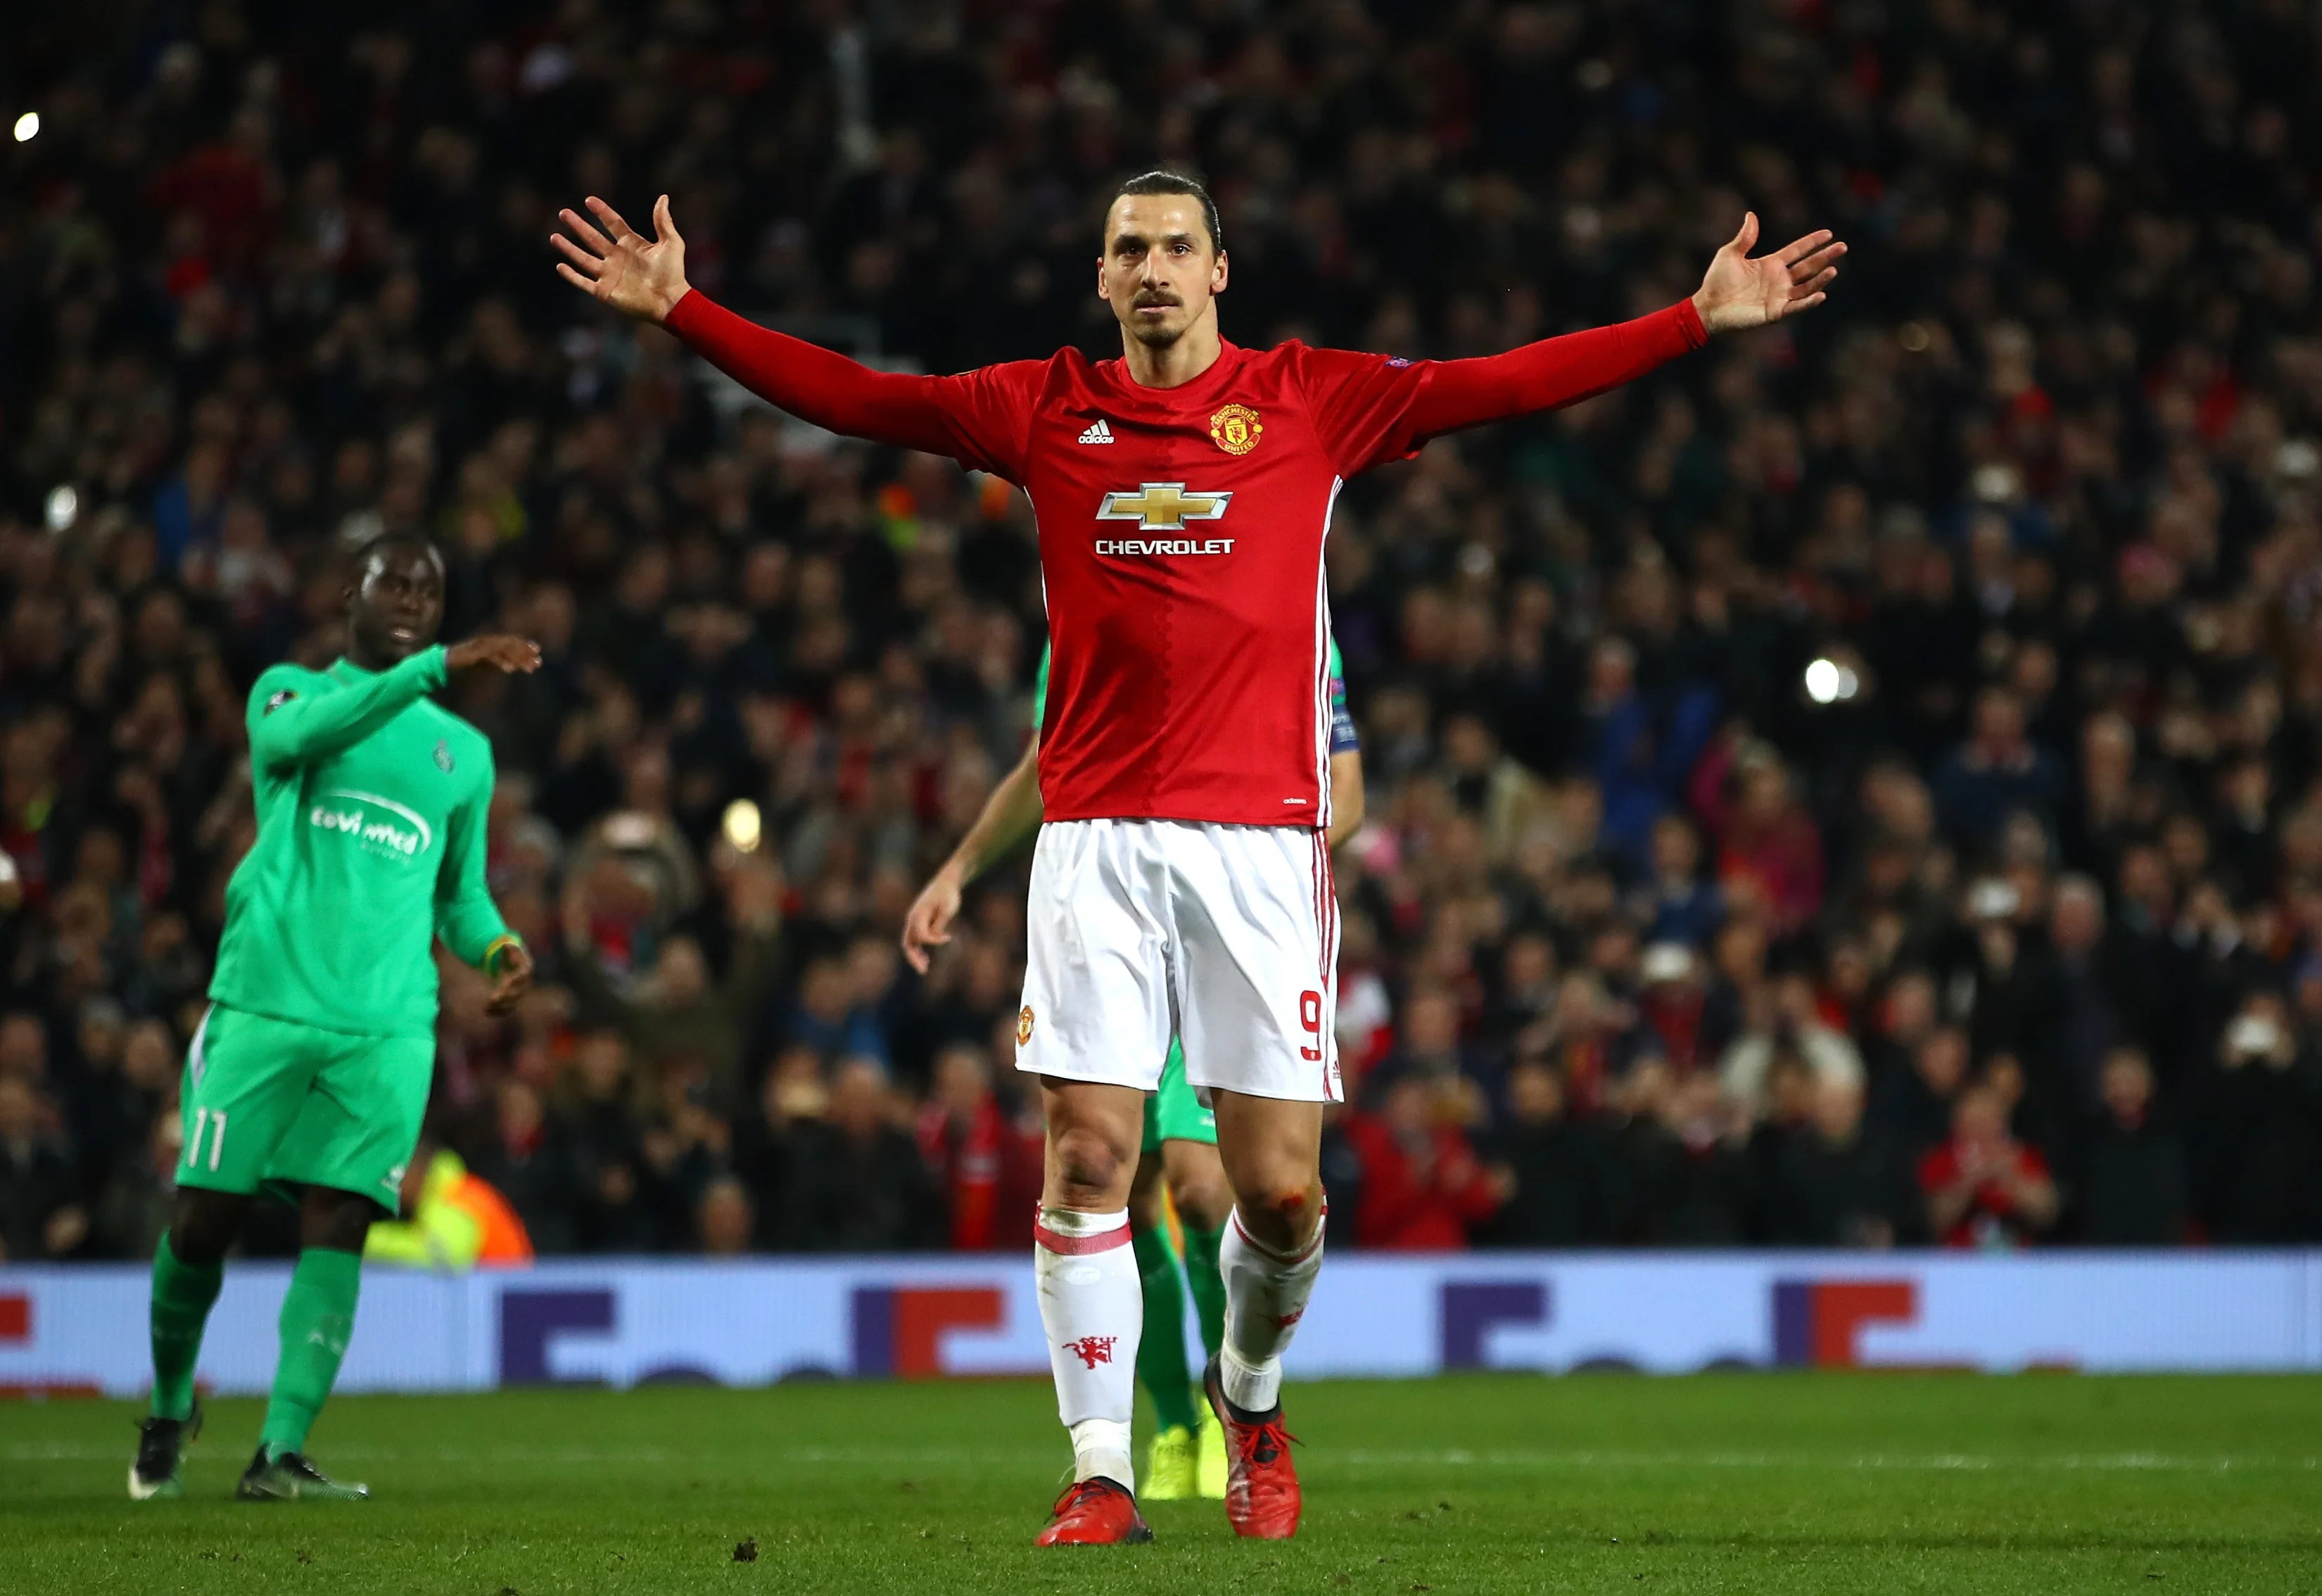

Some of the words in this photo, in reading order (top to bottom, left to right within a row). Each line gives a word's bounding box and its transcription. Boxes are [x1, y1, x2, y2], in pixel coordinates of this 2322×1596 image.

[1214, 407, 1256, 425] MANCHESTER
[1078, 434, 1115, 444] adidas
[1225, 441, 1254, 452] UNITED
[1096, 539, 1235, 555] CHEVROLET
[1300, 989, 1322, 1062] 9
[187, 1106, 227, 1172] 11
